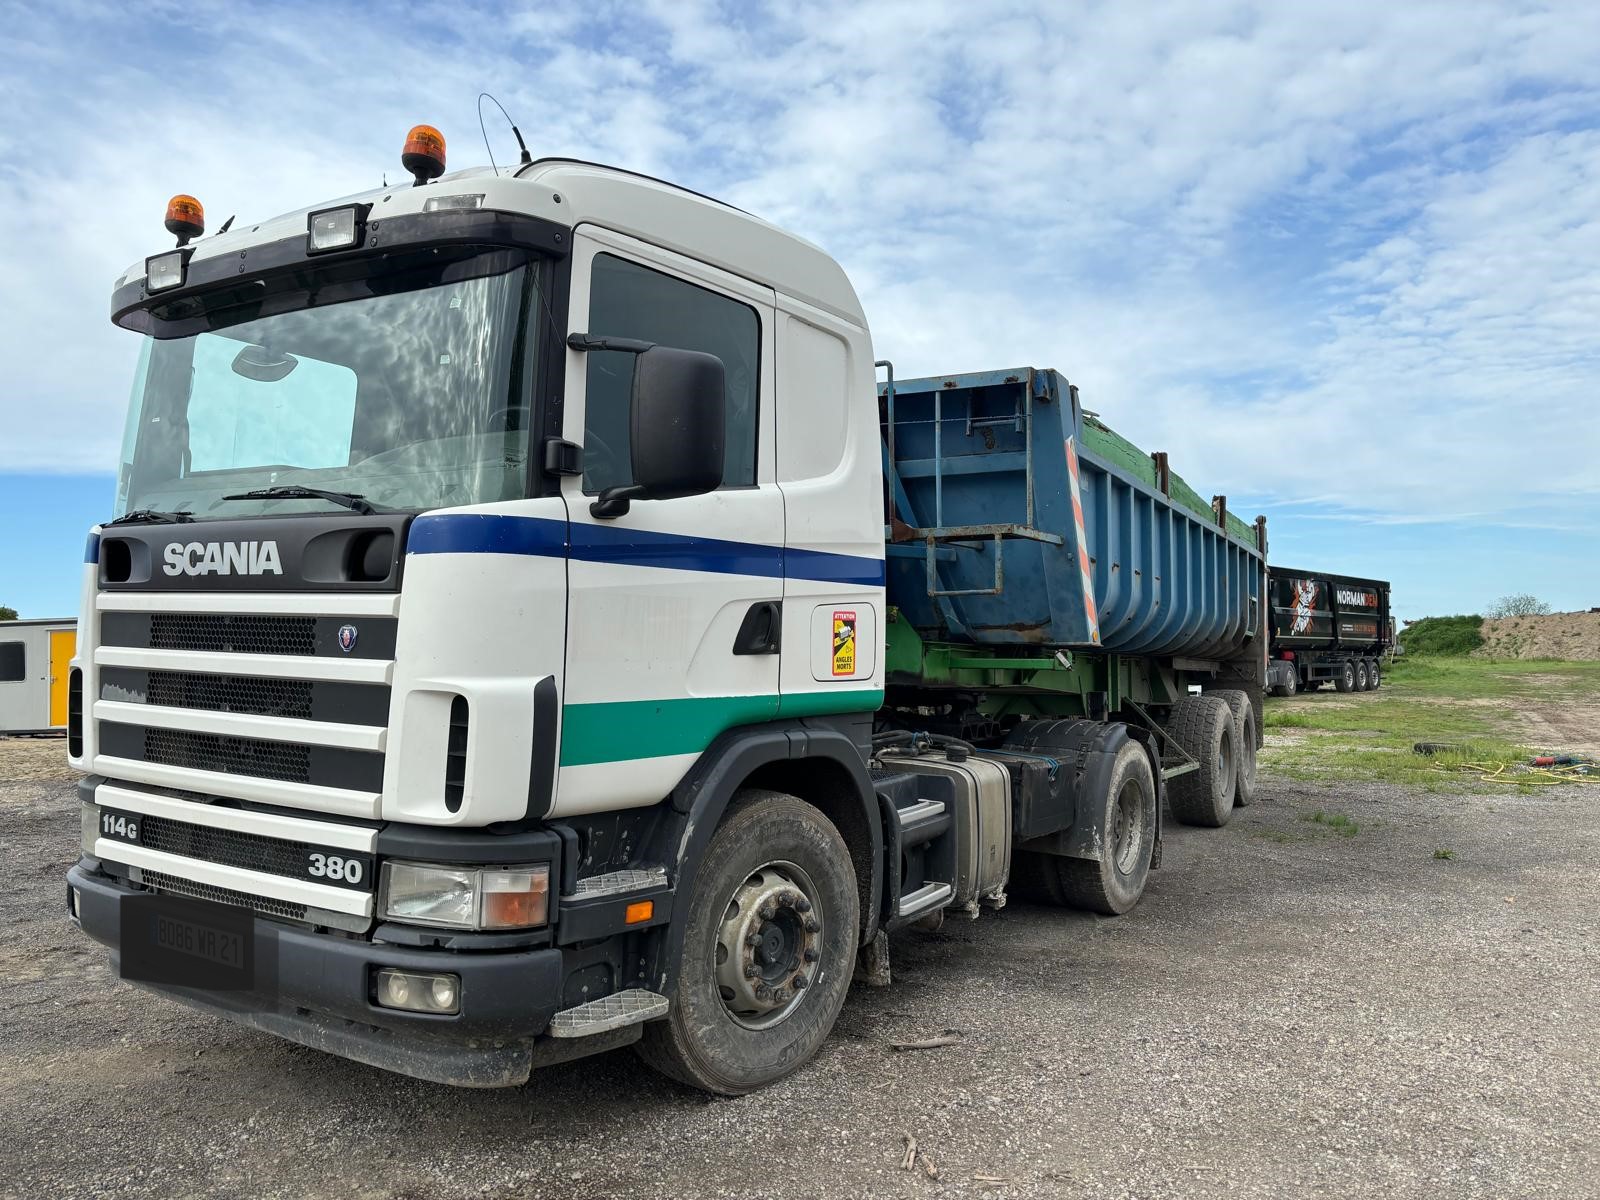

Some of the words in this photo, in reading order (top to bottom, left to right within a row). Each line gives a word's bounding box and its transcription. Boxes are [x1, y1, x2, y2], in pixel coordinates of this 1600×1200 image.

[163, 541, 283, 576] SCANIA
[308, 853, 363, 884] 380
[159, 919, 192, 950] 8086
[220, 934, 238, 964] 21
